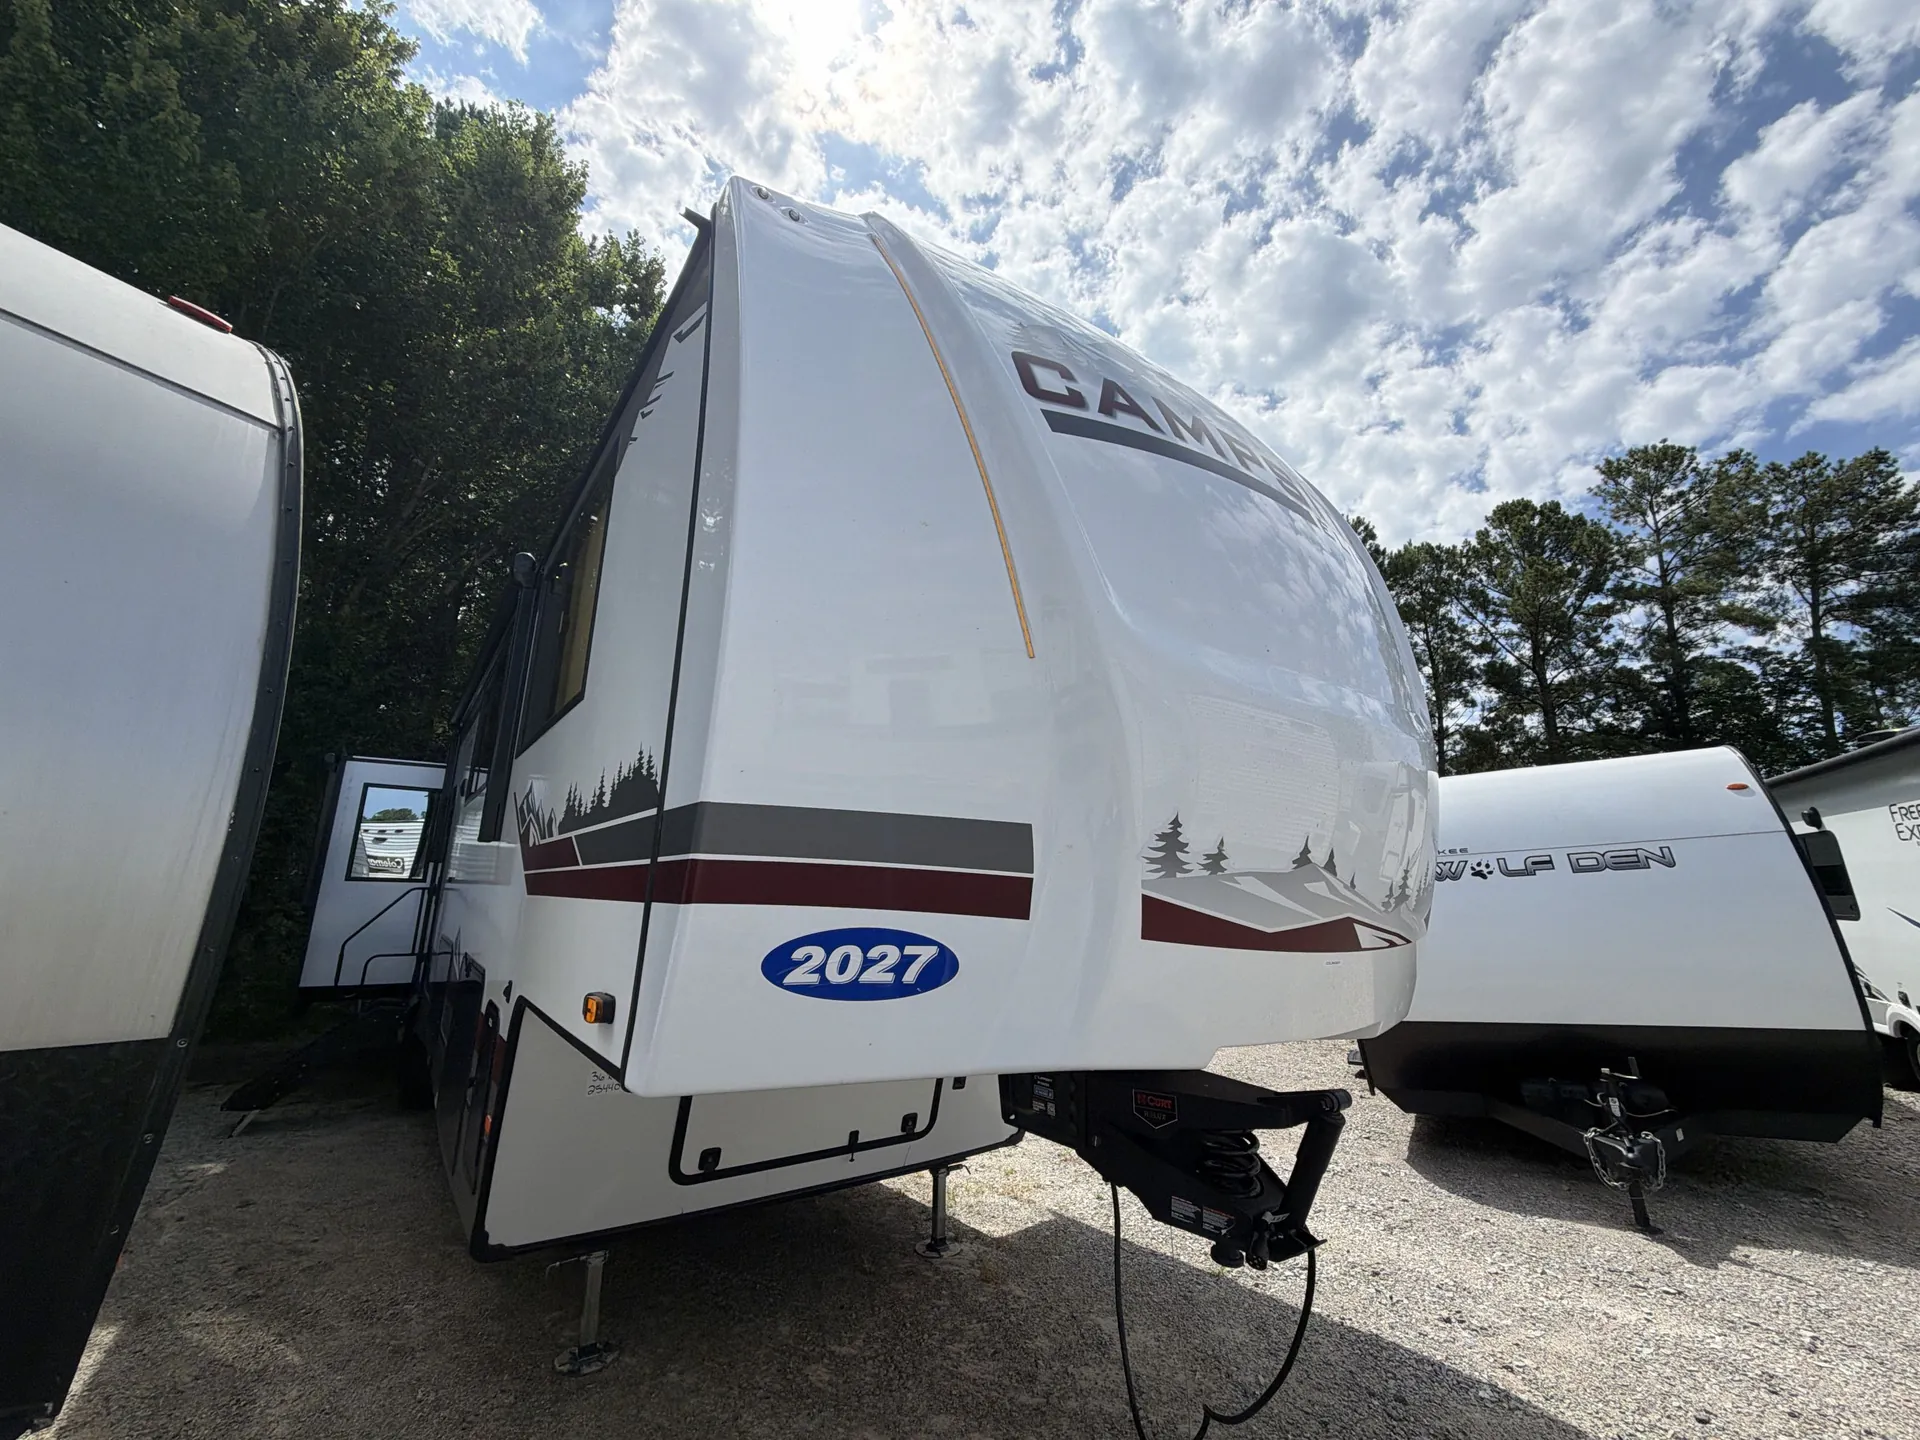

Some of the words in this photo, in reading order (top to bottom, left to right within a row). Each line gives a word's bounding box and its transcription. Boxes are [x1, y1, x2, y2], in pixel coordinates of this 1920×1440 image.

[1567, 846, 1676, 873] DEN
[783, 944, 939, 986] 2027
[587, 1083, 621, 1096] 25440
